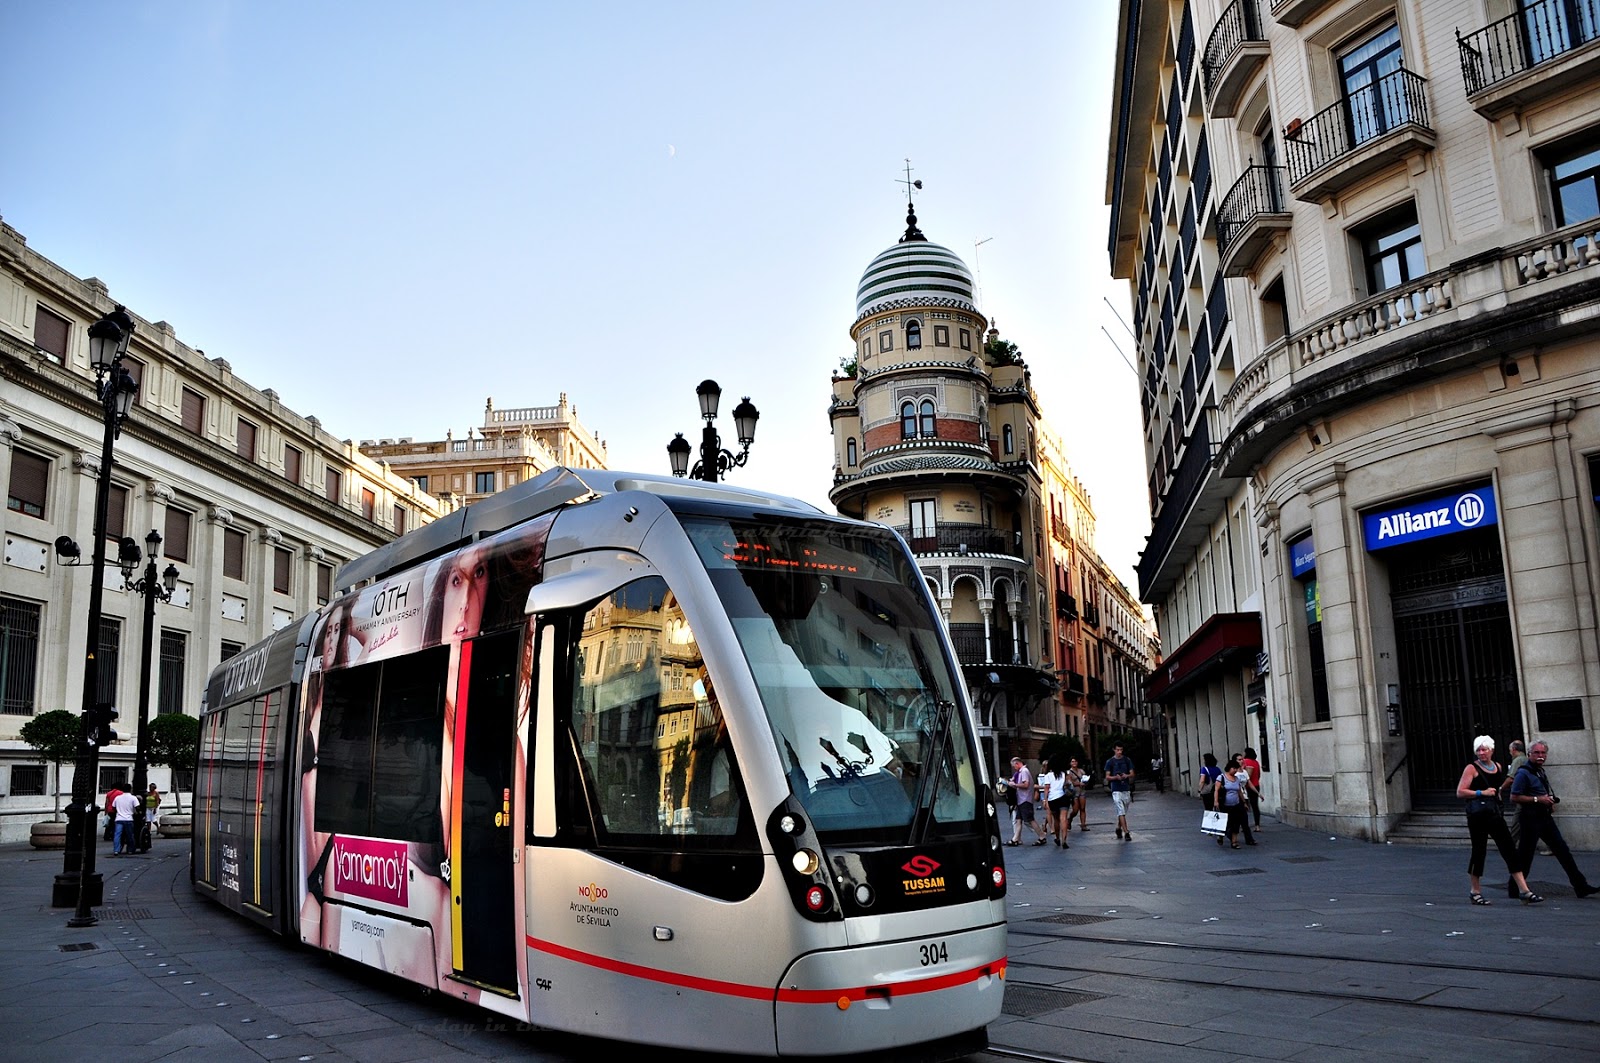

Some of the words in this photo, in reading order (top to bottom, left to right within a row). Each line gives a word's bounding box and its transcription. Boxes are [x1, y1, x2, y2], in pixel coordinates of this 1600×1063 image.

[1378, 508, 1451, 540] Allianz
[371, 582, 411, 618] 10TH
[381, 607, 421, 626] ANNIVERSARY
[903, 877, 945, 891] TUSSAM
[352, 920, 385, 938] yamamay.com
[919, 941, 948, 966] 304
[536, 978, 552, 991] CAF
